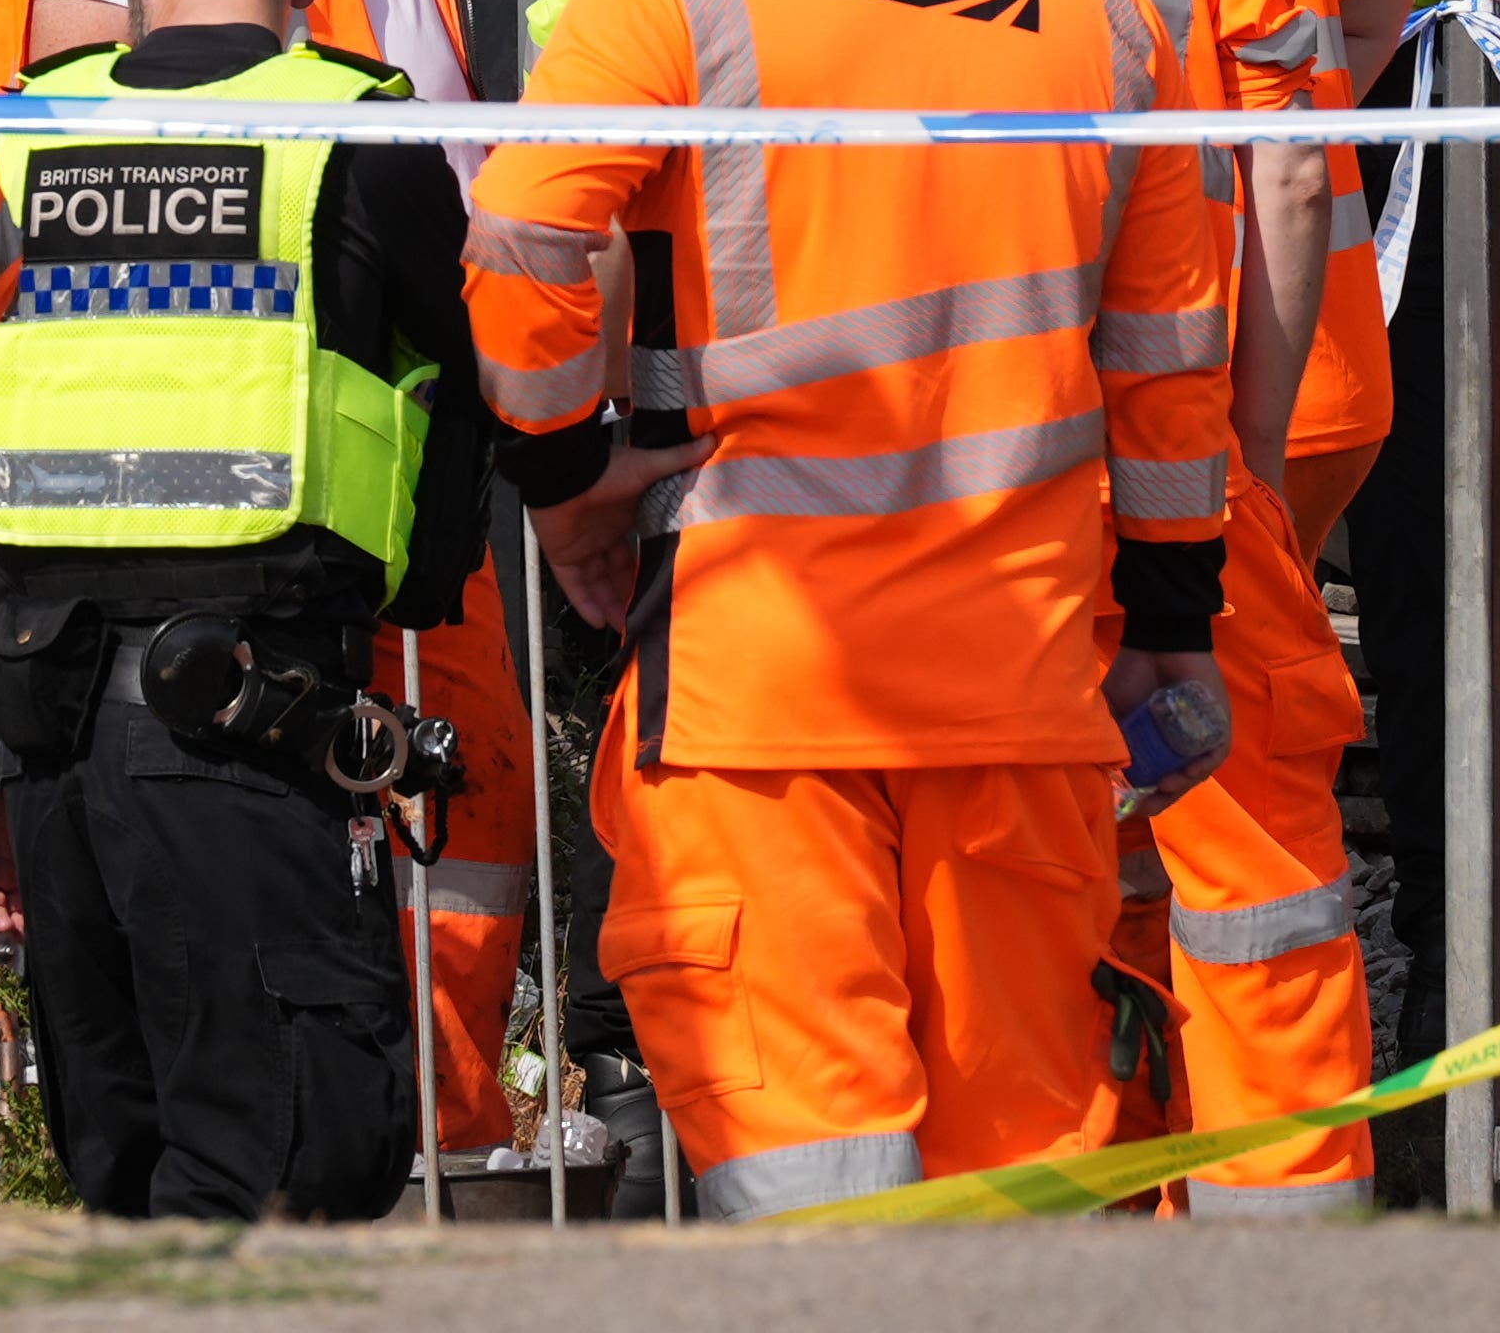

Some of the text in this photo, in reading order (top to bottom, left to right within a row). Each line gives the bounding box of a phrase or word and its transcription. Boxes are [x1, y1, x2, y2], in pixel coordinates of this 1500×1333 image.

[39, 166, 249, 186] BRITISH TRANSPORT
[29, 187, 249, 238] POLICE
